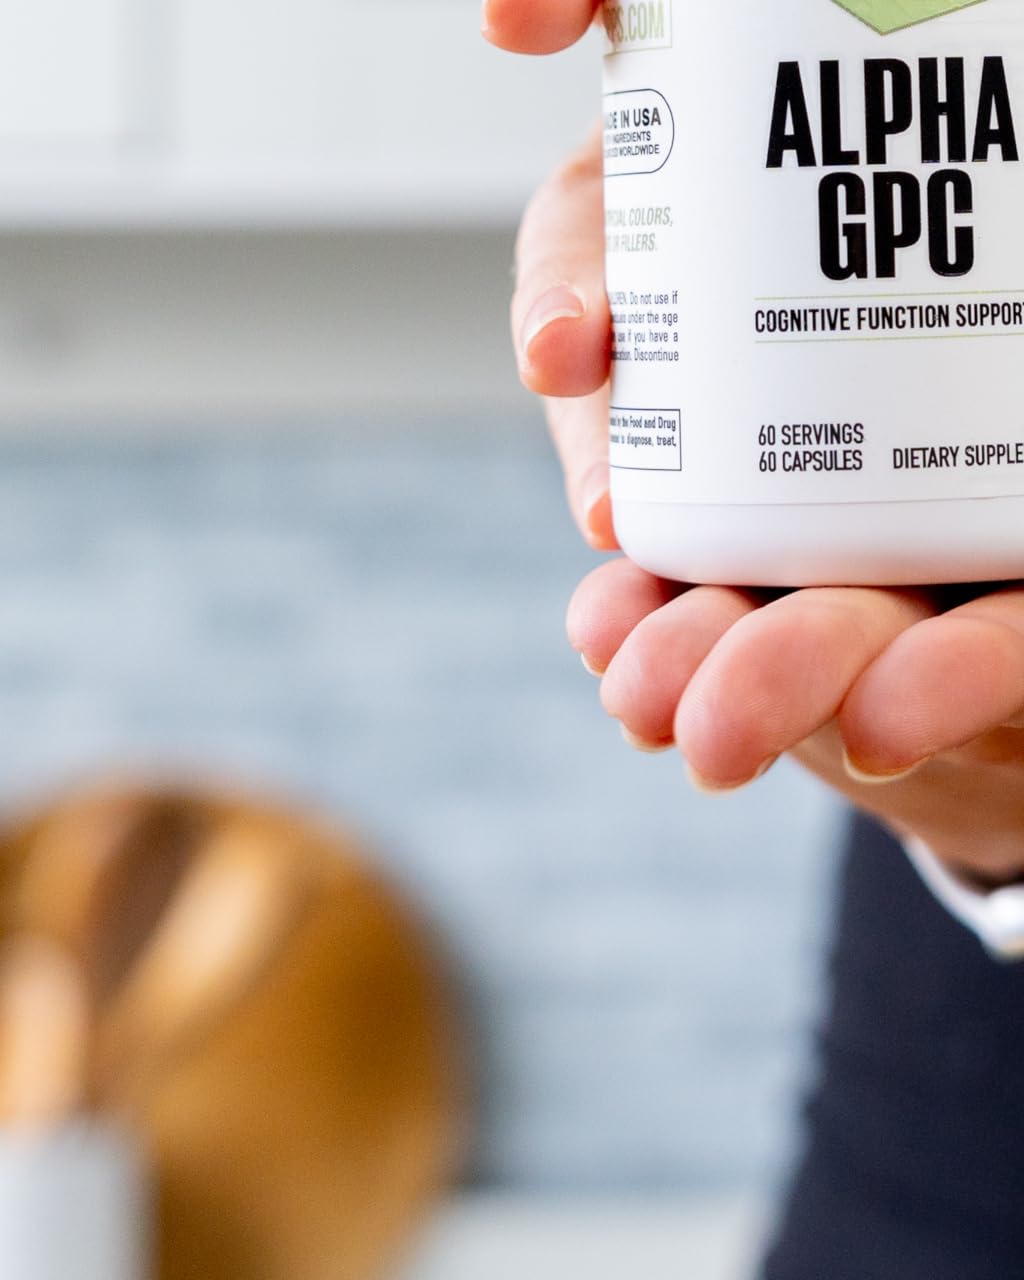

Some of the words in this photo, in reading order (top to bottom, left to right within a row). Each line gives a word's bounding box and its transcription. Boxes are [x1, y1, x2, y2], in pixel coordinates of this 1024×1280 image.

[620, 109, 630, 128] IN
[633, 106, 661, 127] USA
[765, 55, 1020, 169] ALPHA
[613, 130, 651, 144] INGREDIENTS
[619, 144, 660, 157] WORLDWIDE
[629, 206, 673, 227] COLORS,
[818, 168, 975, 281] GPC
[640, 293, 652, 304] not
[654, 293, 669, 304] use
[672, 290, 678, 304] if
[647, 310, 659, 324] the
[662, 313, 678, 326] age
[754, 307, 851, 333] COGNITIVE
[857, 304, 951, 331] FUNCTION
[634, 331, 646, 345] you
[649, 329, 669, 342] have
[673, 331, 678, 342] a
[634, 346, 679, 361] Discontinue
[630, 416, 643, 429] Food
[644, 417, 656, 429] and
[658, 416, 676, 432] Drug
[627, 433, 654, 448] diagnose,
[657, 435, 677, 447] treat,
[758, 425, 776, 446] 60
[781, 423, 865, 446] SERVINGS
[759, 452, 777, 472] 60
[782, 449, 863, 472] CAPSULES
[893, 446, 960, 470] DIETARY
